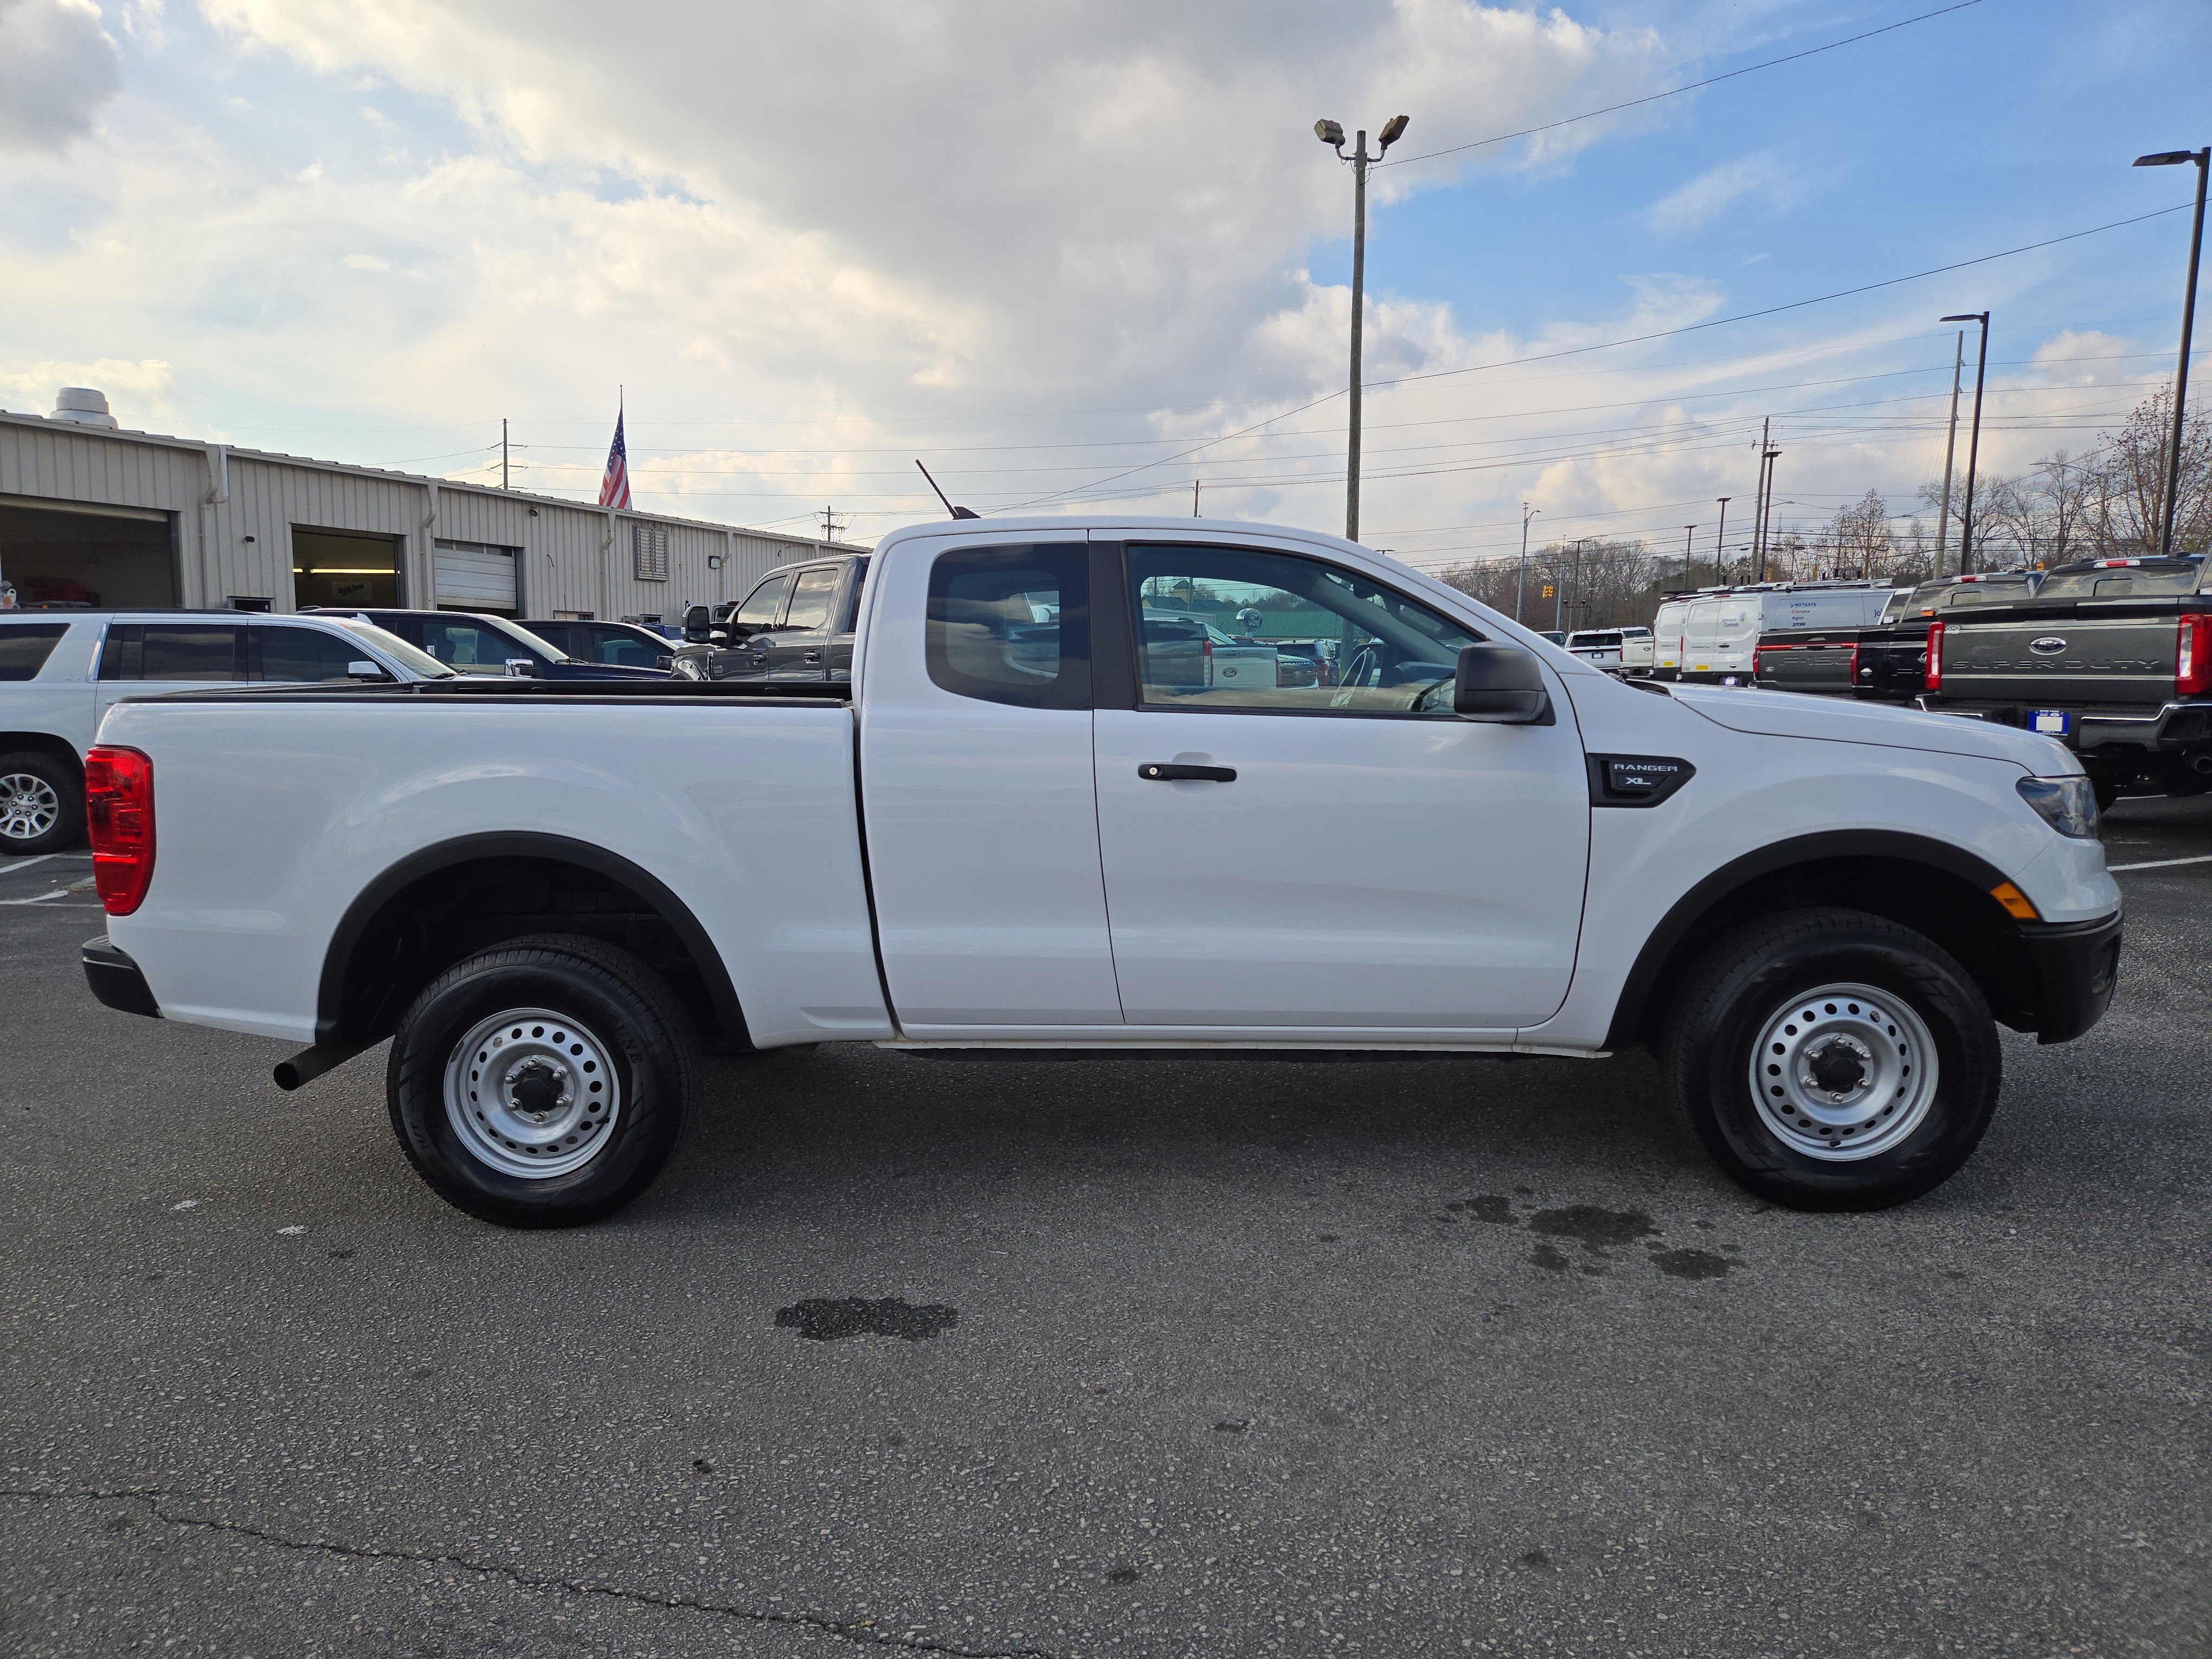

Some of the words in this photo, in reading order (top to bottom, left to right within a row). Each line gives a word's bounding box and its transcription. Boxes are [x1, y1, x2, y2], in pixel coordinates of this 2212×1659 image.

[1952, 659, 2055, 669] SUPER
[2065, 659, 2160, 669] DUTY
[1614, 763, 1678, 772] RANGER
